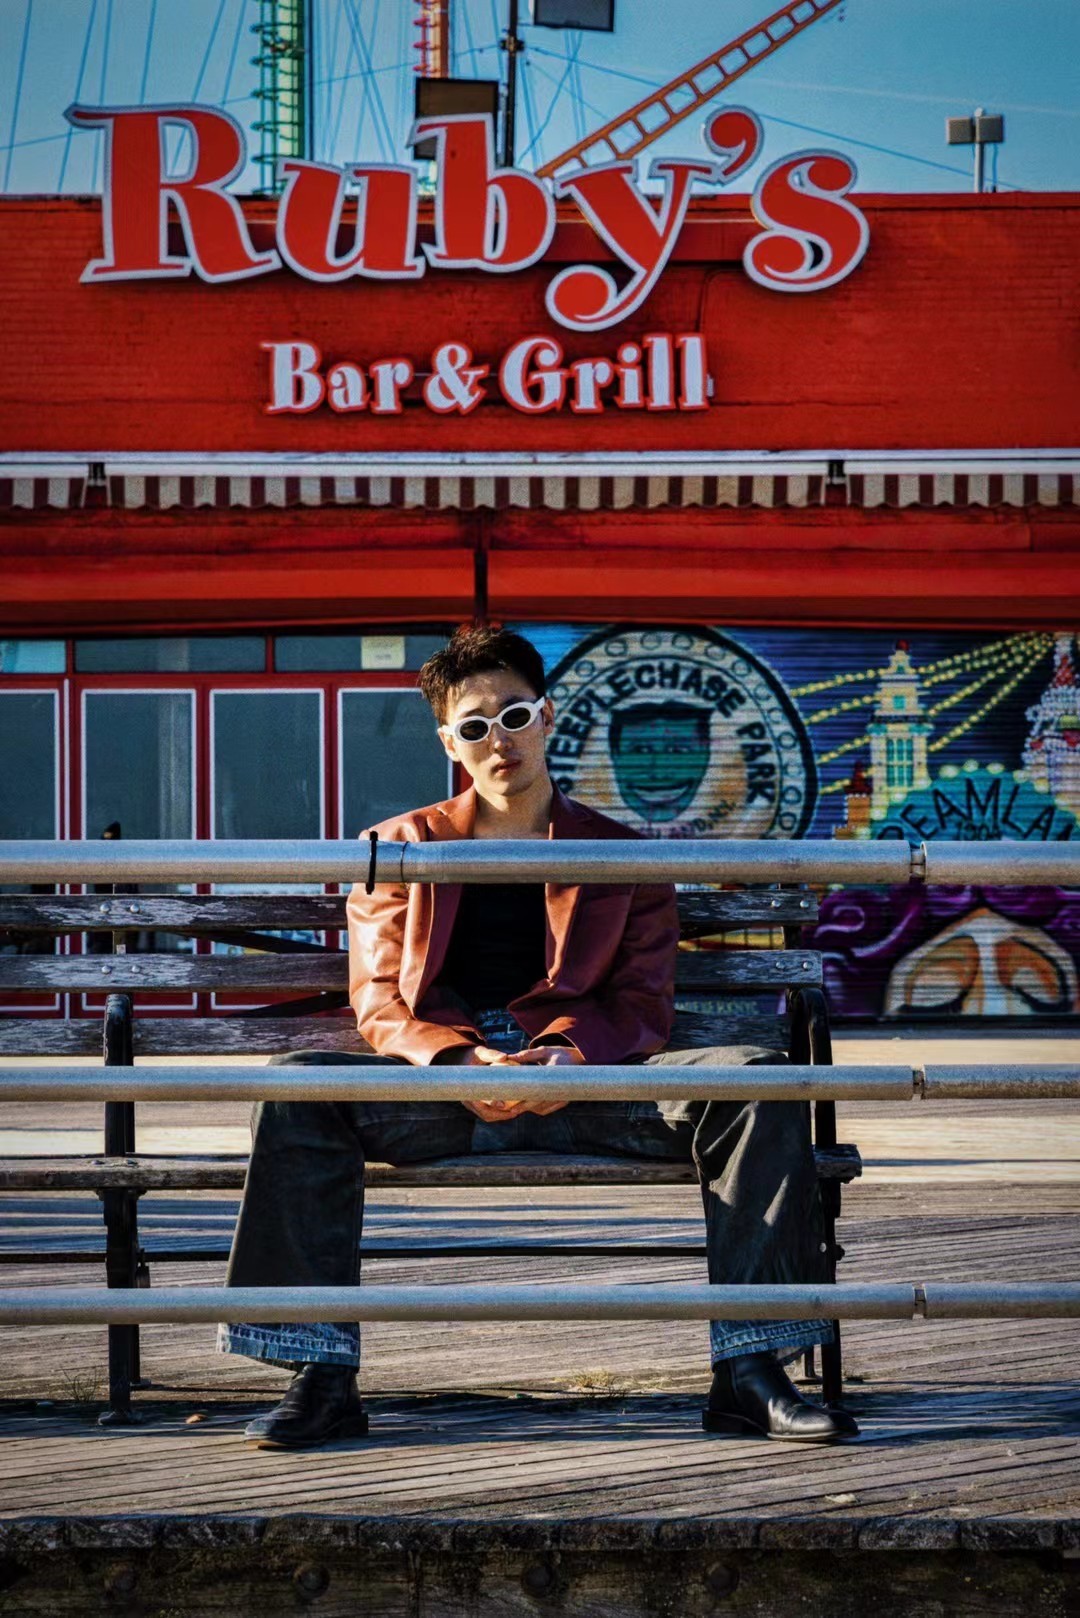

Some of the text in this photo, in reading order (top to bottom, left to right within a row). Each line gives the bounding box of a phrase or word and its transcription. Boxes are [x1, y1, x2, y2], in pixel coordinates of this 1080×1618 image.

[63, 104, 870, 332] Ruby's
[260, 334, 706, 414] Bar & Grill
[736, 720, 777, 804] PARK
